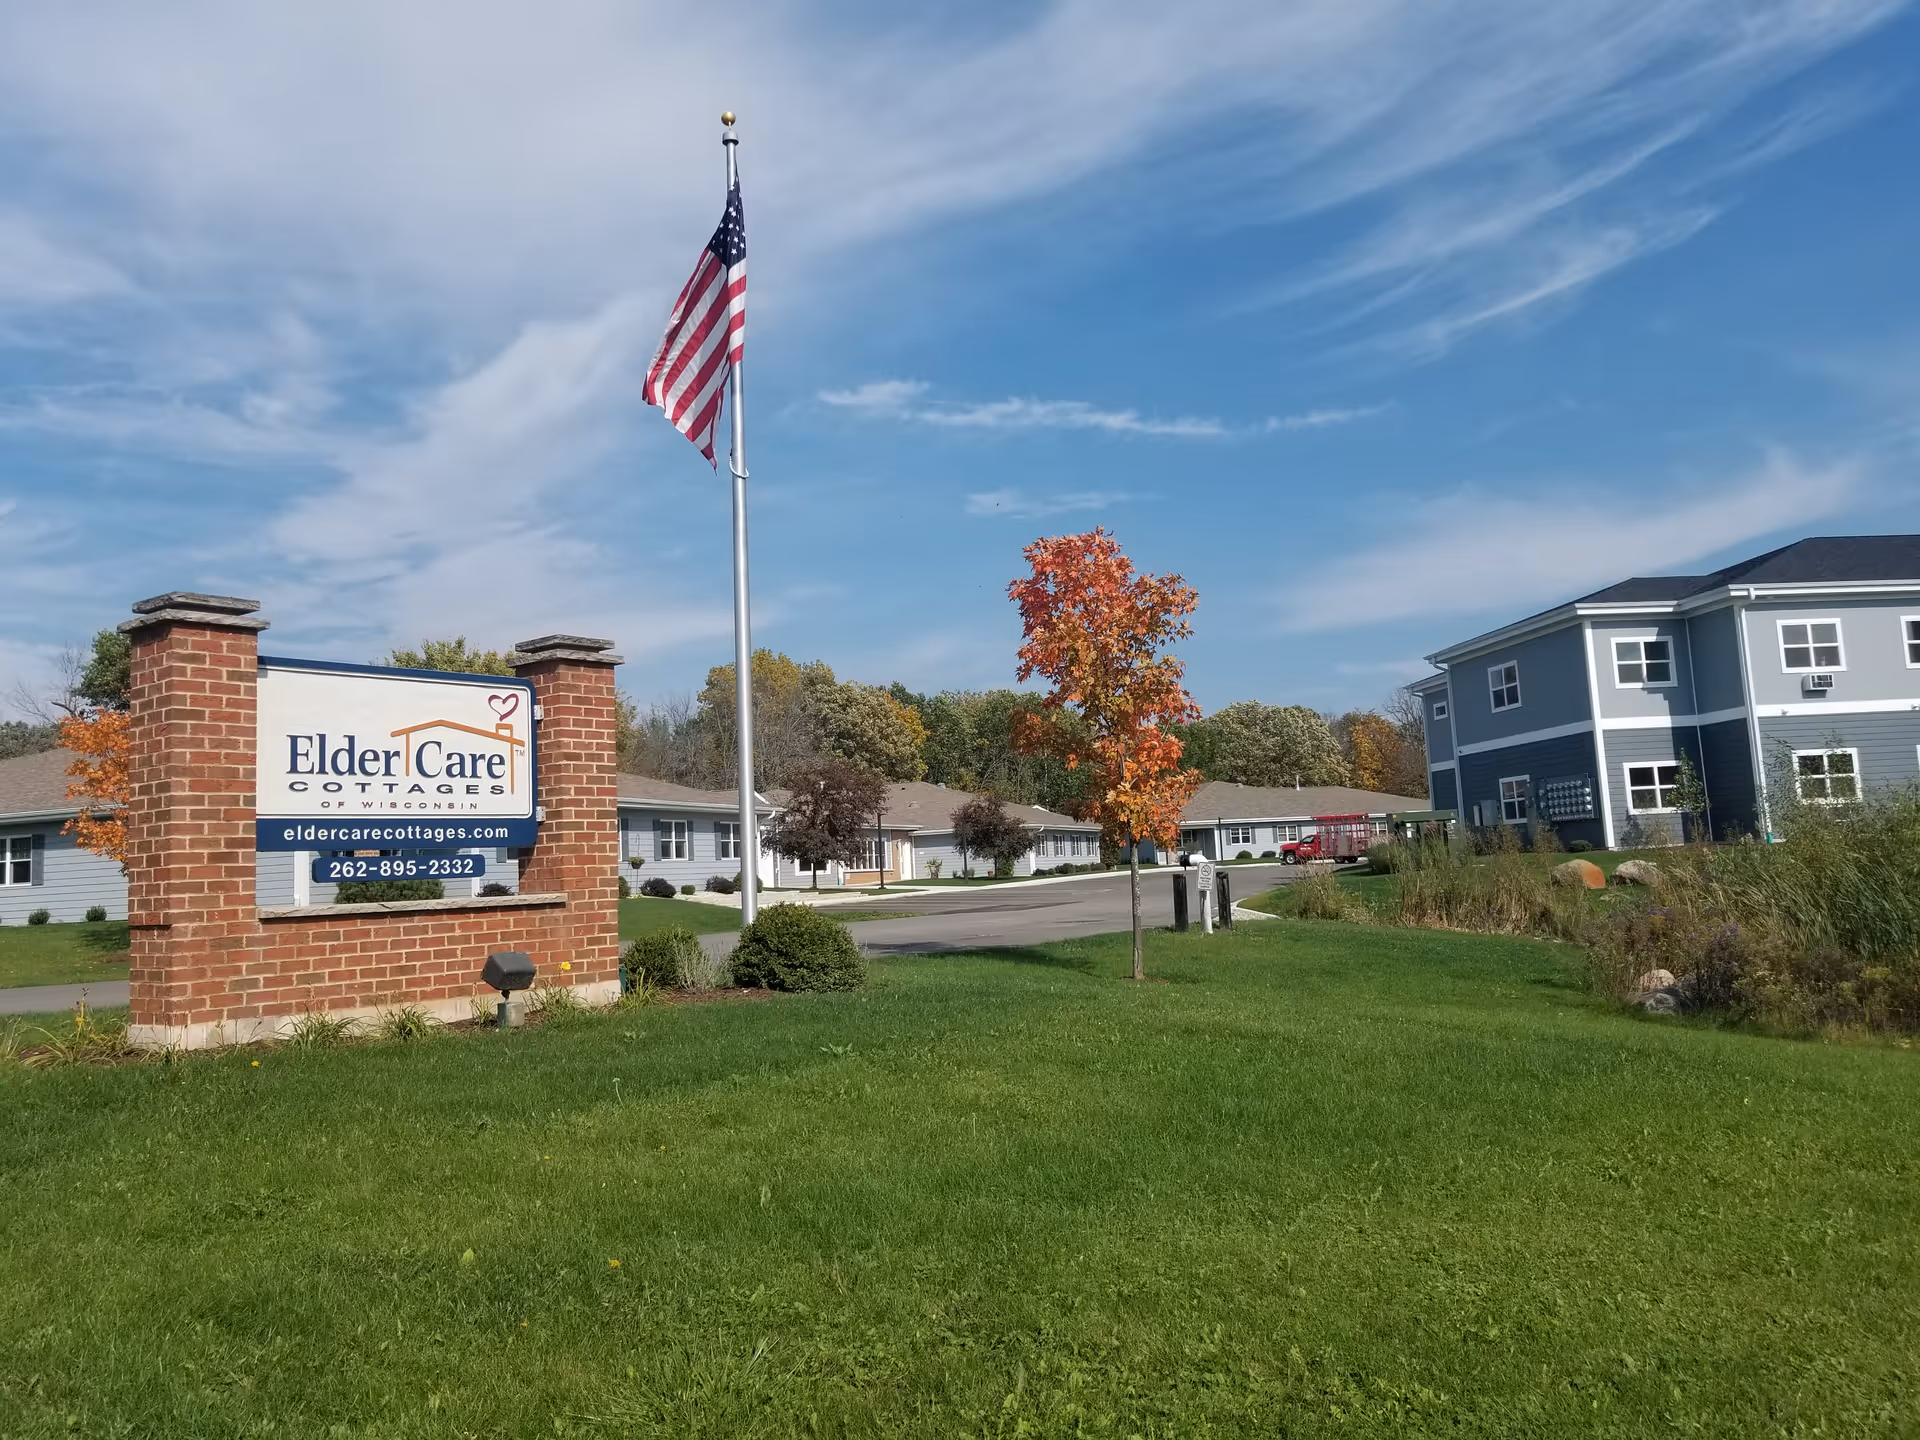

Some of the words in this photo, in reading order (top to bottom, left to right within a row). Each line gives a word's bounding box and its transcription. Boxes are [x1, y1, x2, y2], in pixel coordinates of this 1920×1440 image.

[286, 733, 400, 777] Elder
[415, 740, 506, 779] Care
[288, 781, 505, 795] COTTAGES
[361, 801, 478, 810] WISCONSIN
[283, 825, 509, 842] eldercarecottages.com
[330, 859, 474, 878] 262-895-2332
